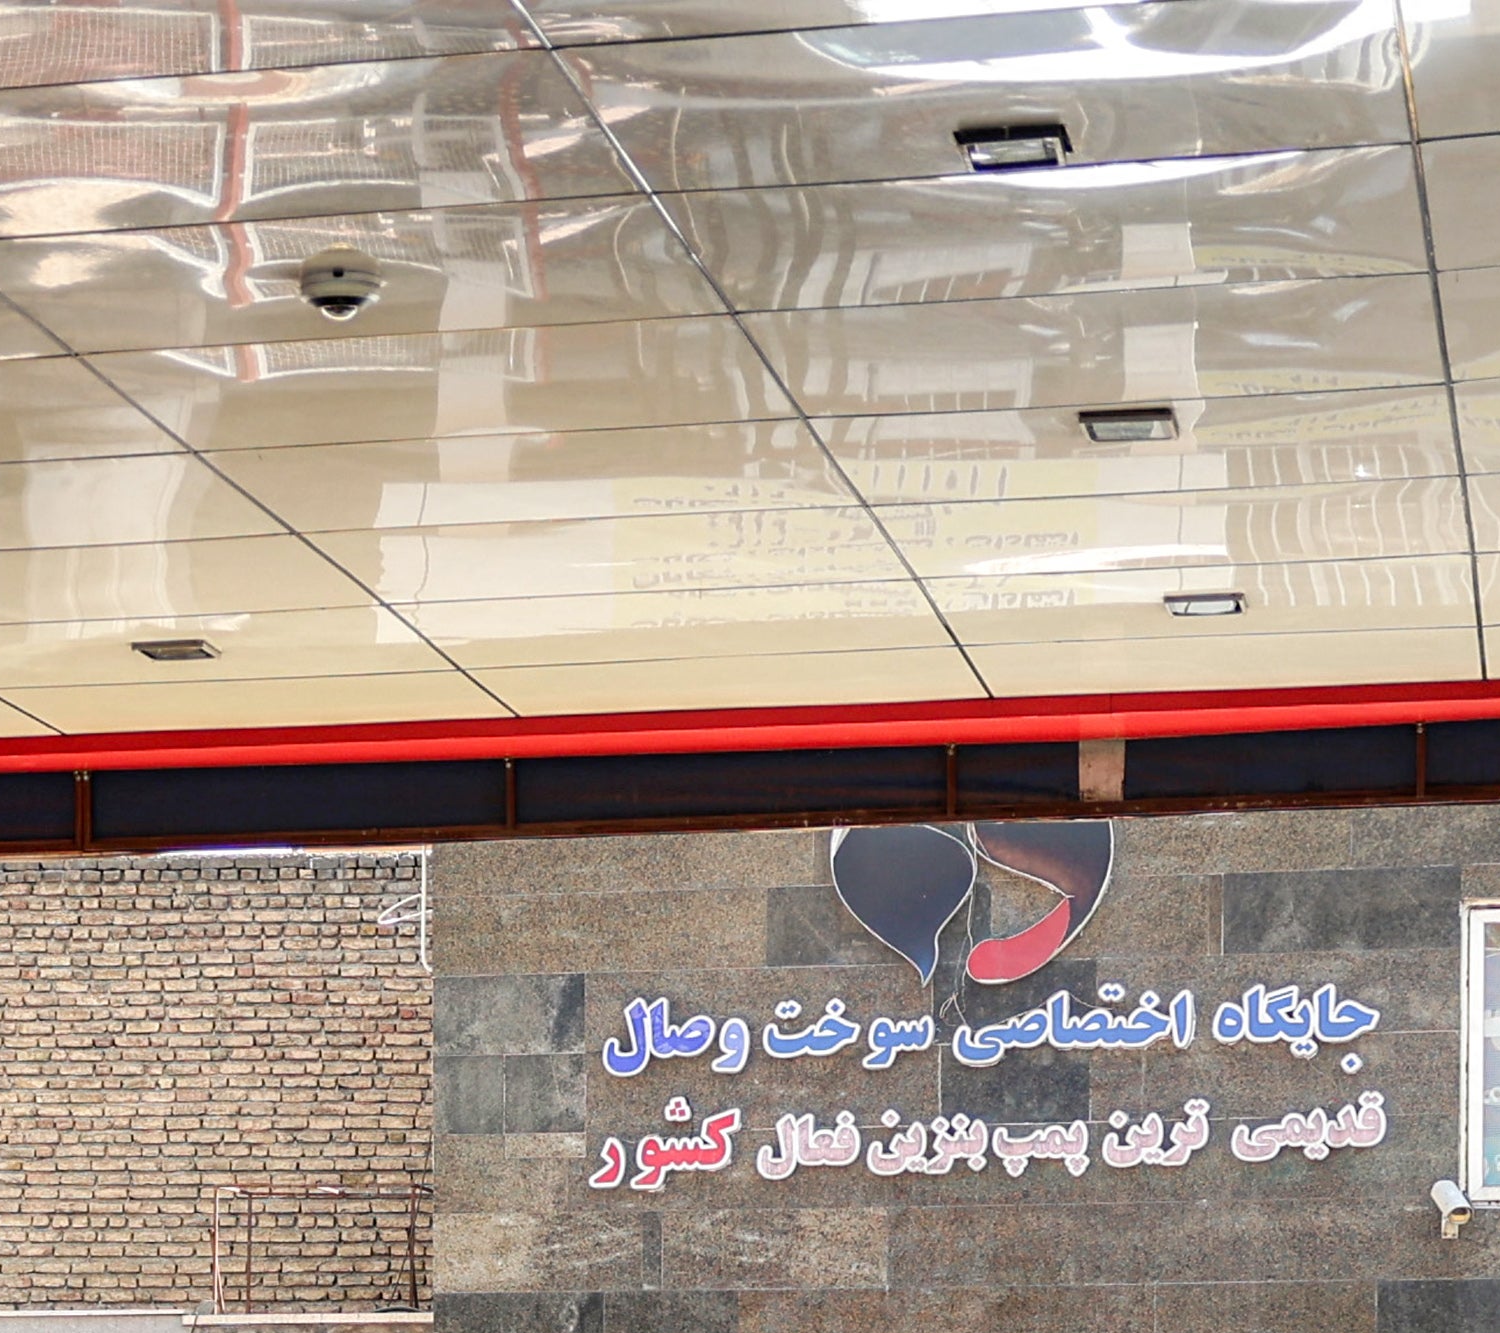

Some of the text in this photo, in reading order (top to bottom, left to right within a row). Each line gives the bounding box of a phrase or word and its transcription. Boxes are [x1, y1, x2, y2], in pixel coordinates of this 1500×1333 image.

[602, 980, 1380, 1078] جایگاه اختصاصی سوخت وصال
[589, 1090, 1387, 1192] قدیمی ترین پمپ بنزین فعال کشور
